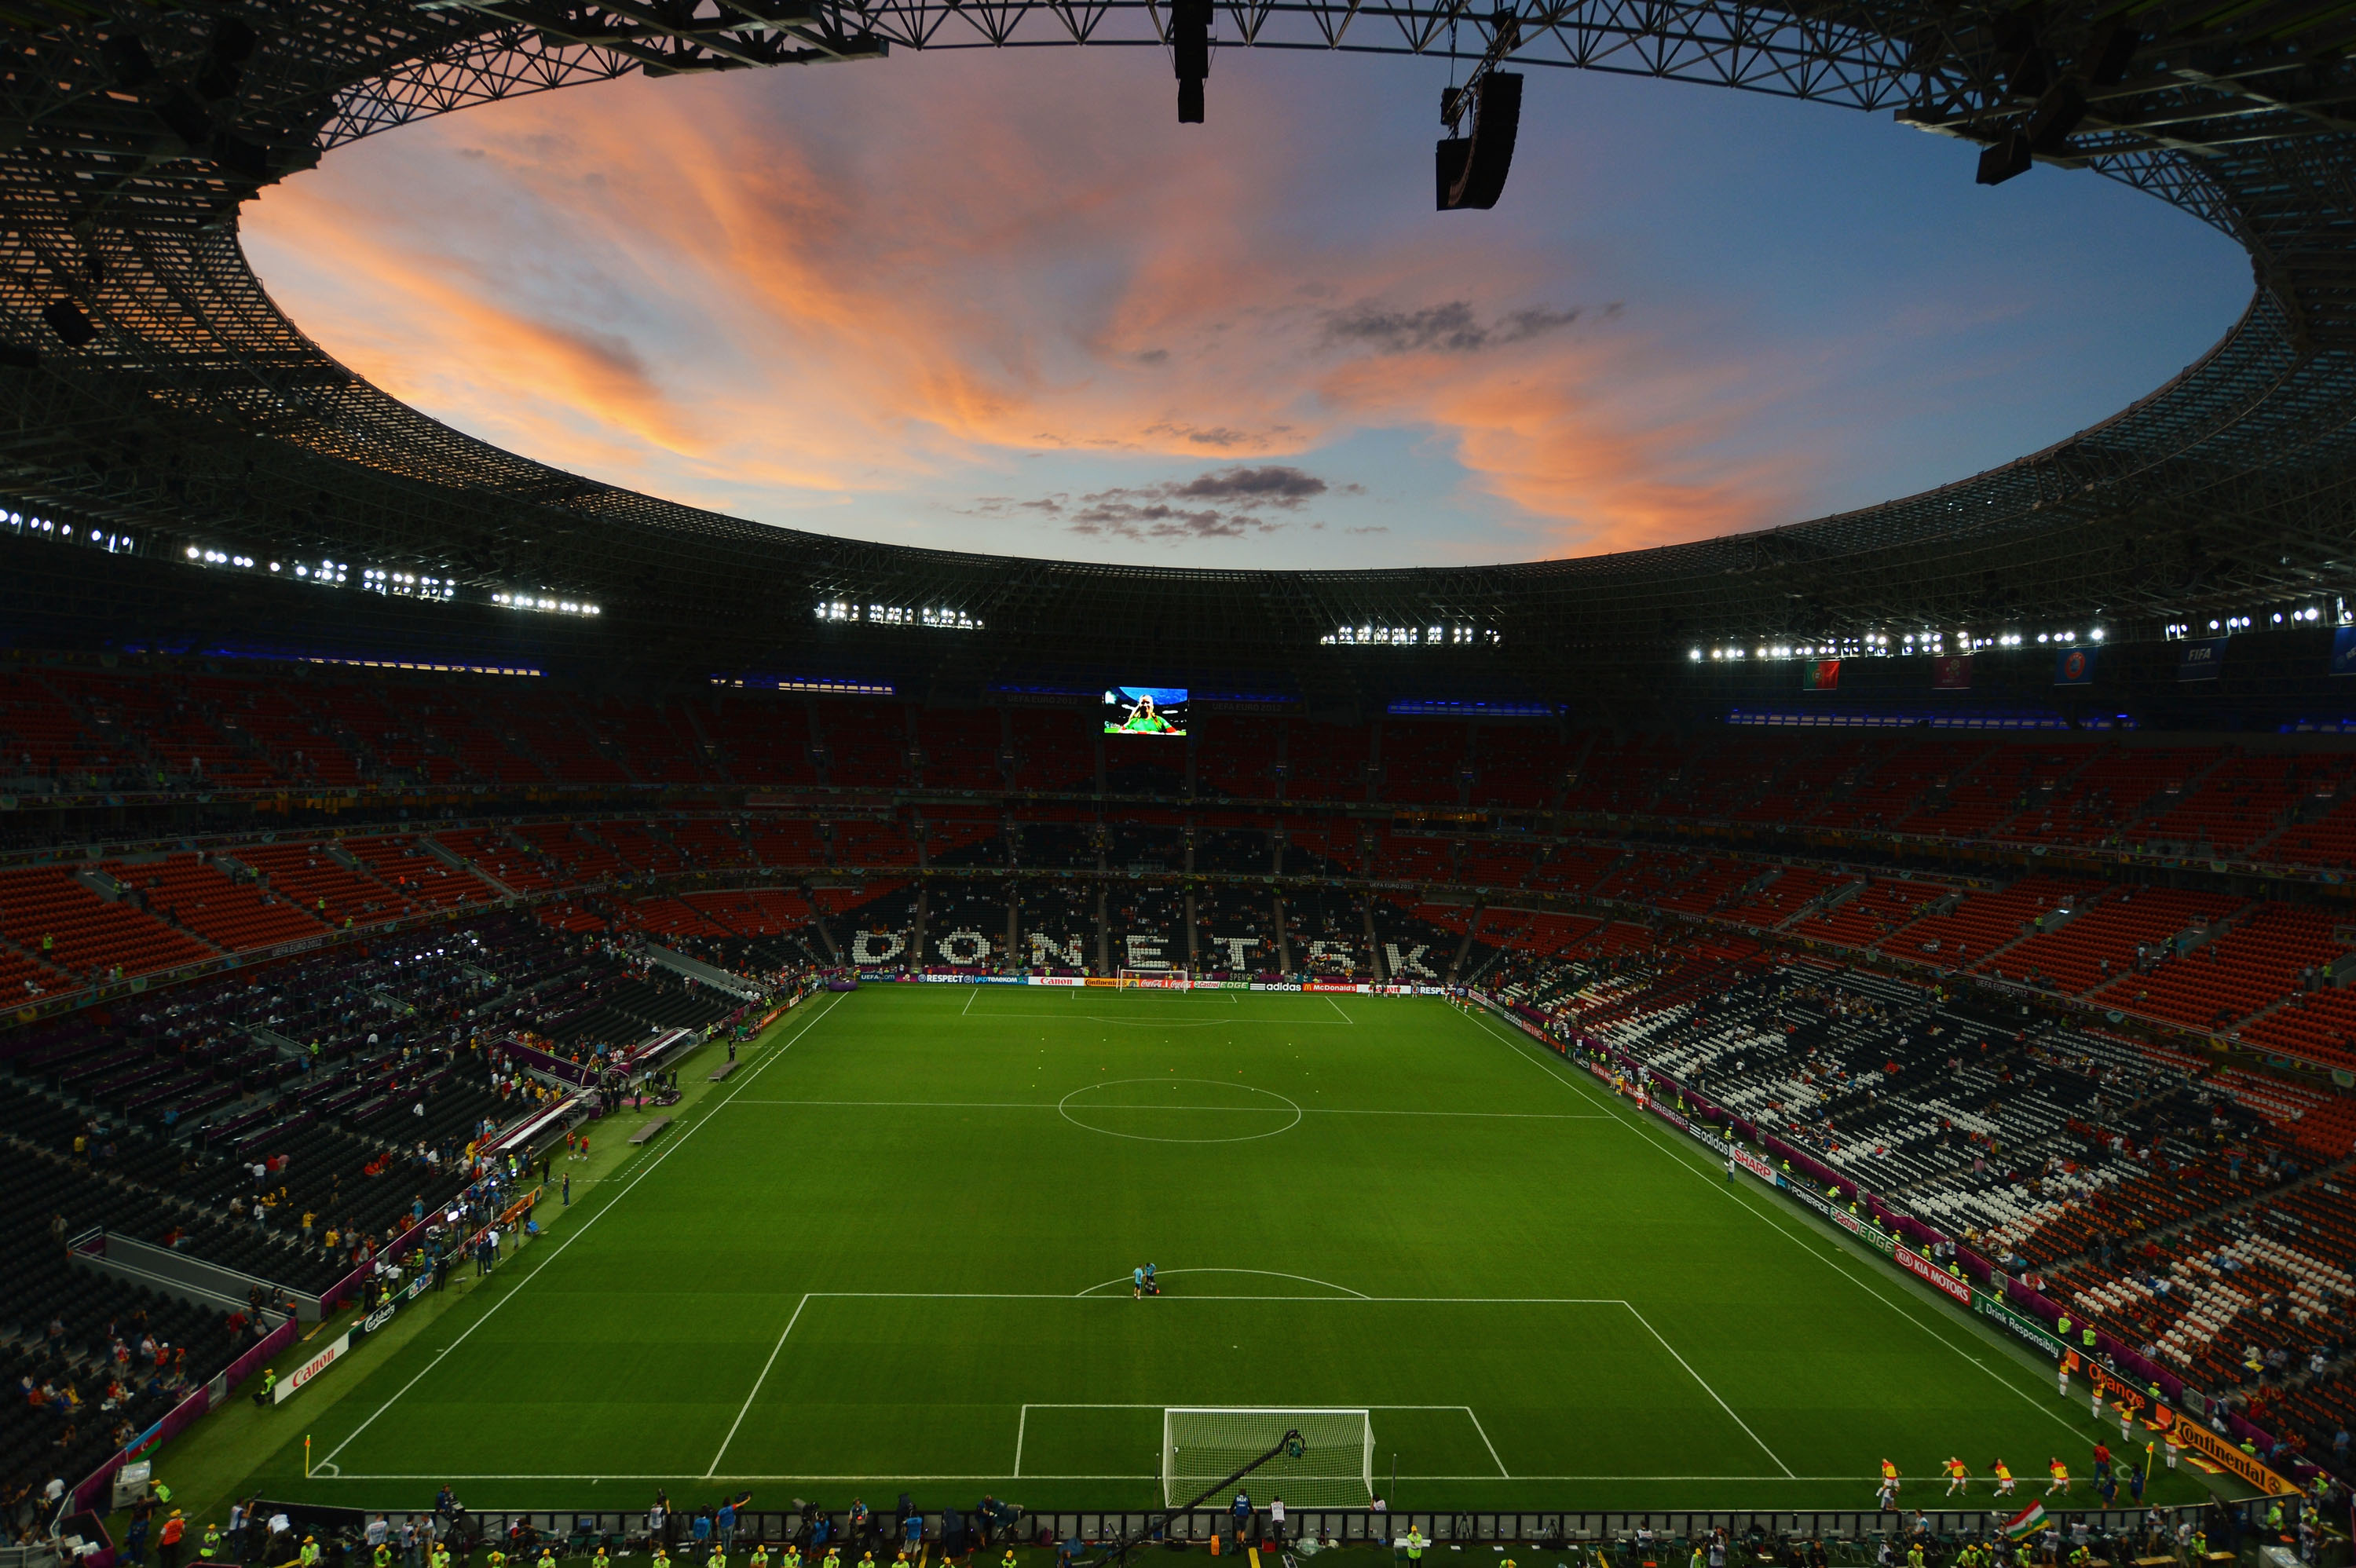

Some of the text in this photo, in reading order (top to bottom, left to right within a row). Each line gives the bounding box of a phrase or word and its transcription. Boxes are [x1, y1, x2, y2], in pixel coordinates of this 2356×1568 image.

[2188, 648, 2211, 661] FIFA
[852, 929, 1439, 978] DONETSK
[927, 974, 964, 983] RESPECT
[1040, 977, 1073, 985] Canon
[1266, 982, 1301, 992] adidas
[1976, 978, 2029, 998] UEFA EURO 2012
[1701, 1129, 1729, 1156] adidas
[1734, 1150, 1772, 1178] SHARP
[1792, 1186, 1829, 1215] POWERADE
[1835, 1212, 1895, 1254] Castrol EDGE
[1898, 1251, 1911, 1264] KIA
[1914, 1259, 1929, 1277] KIA
[1930, 1270, 1969, 1302] MOTORS
[364, 1303, 395, 1332] Carlsberg
[1985, 1303, 2059, 1359] Drink Responsibly
[292, 1348, 335, 1387] Canon
[2088, 1362, 2146, 1409] Orange
[2179, 1420, 2266, 1489] Continental
